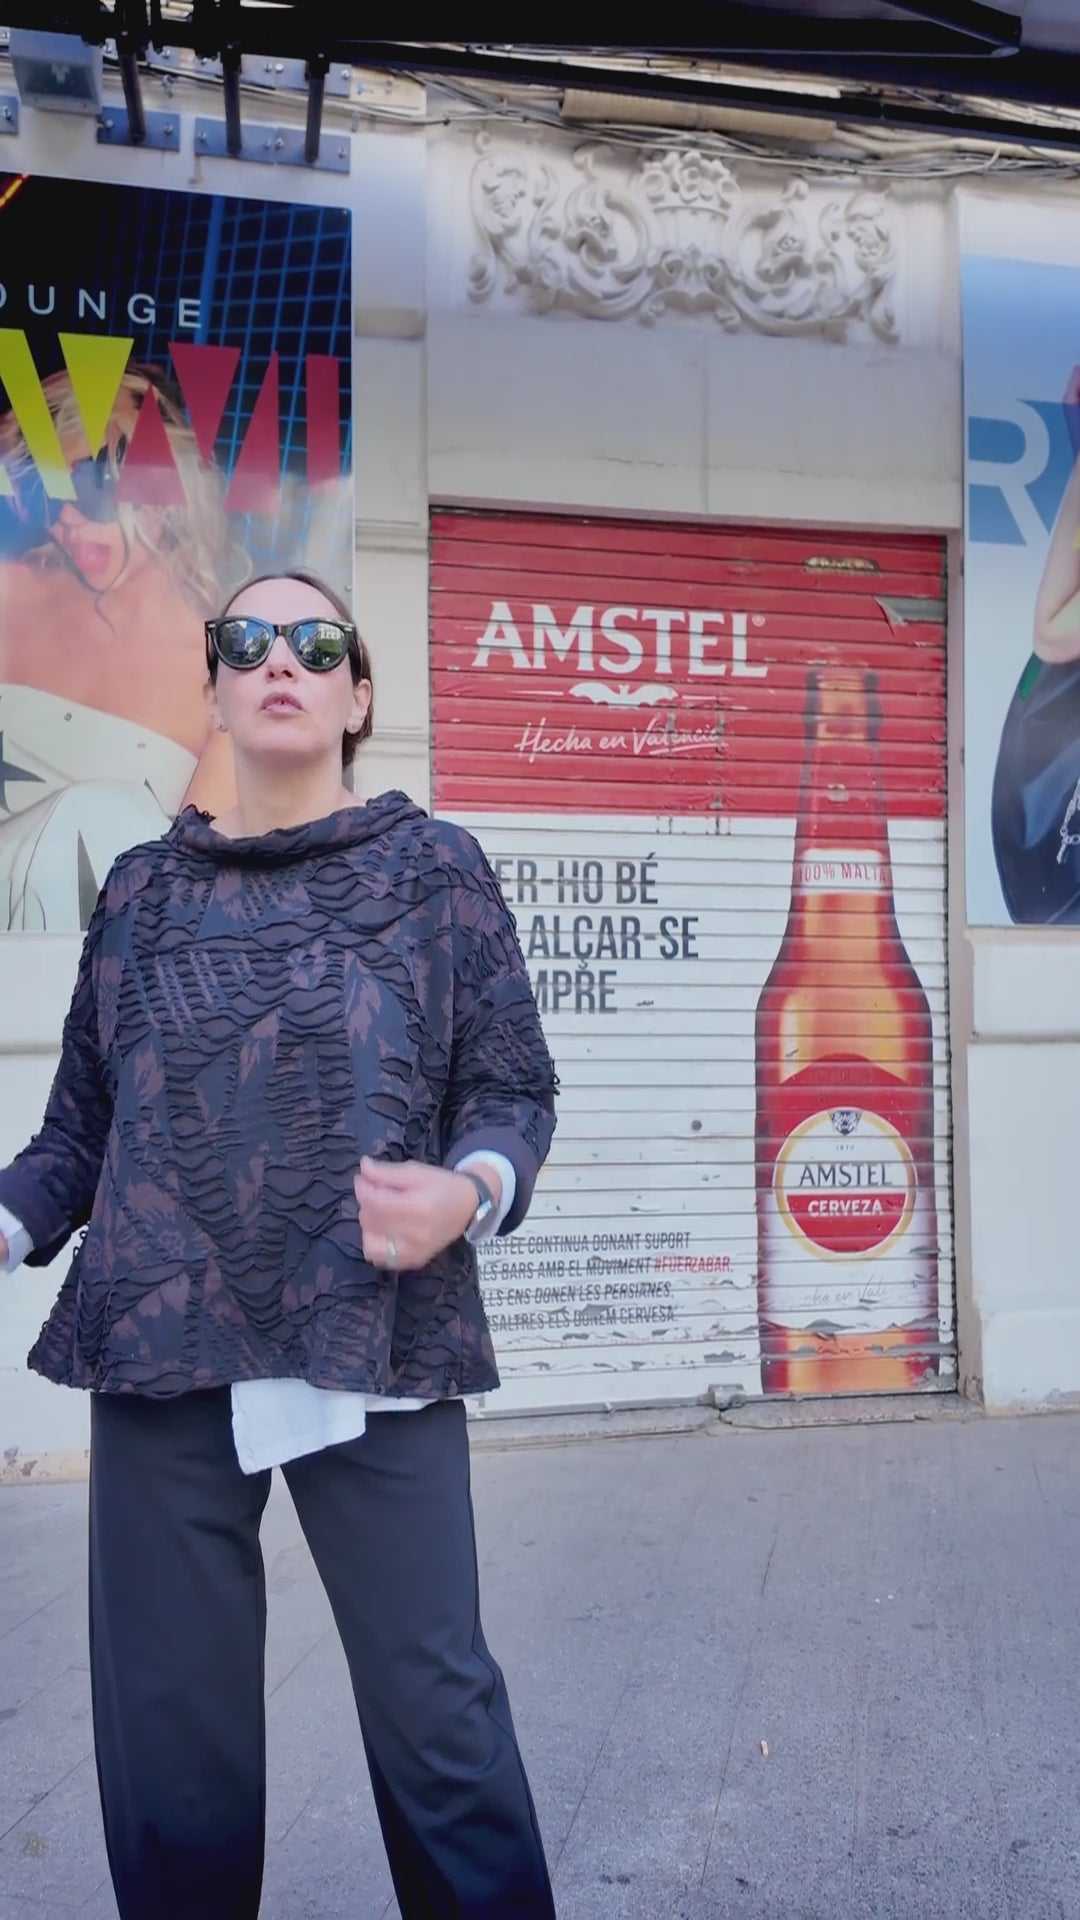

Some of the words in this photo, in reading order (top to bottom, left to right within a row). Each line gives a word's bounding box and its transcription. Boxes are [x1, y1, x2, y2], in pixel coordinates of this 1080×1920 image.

[0, 282, 202, 329] UNGE
[514, 716, 593, 763] Hecha
[599, 734, 627, 749] en
[488, 859, 603, 905] ER-HO
[616, 852, 658, 904] BÉ
[841, 862, 886, 884] MALTA
[527, 914, 699, 970] ALÇAR-SE
[799, 1163, 892, 1187] AMSTEL
[807, 1199, 884, 1218] CERVEZA
[528, 1234, 589, 1254] CONTINUA
[593, 1233, 641, 1251] DONANT
[645, 1231, 691, 1249] SUPORT
[501, 1261, 534, 1280] BARS
[537, 1259, 565, 1278] AMB
[569, 1259, 583, 1277] EL
[586, 1256, 652, 1275] MOVIMENT
[507, 1287, 531, 1306] ENS
[534, 1284, 575, 1304] DONEN
[580, 1283, 601, 1302] LES
[487, 1313, 544, 1332] SALTRES
[548, 1309, 570, 1329] ELS
